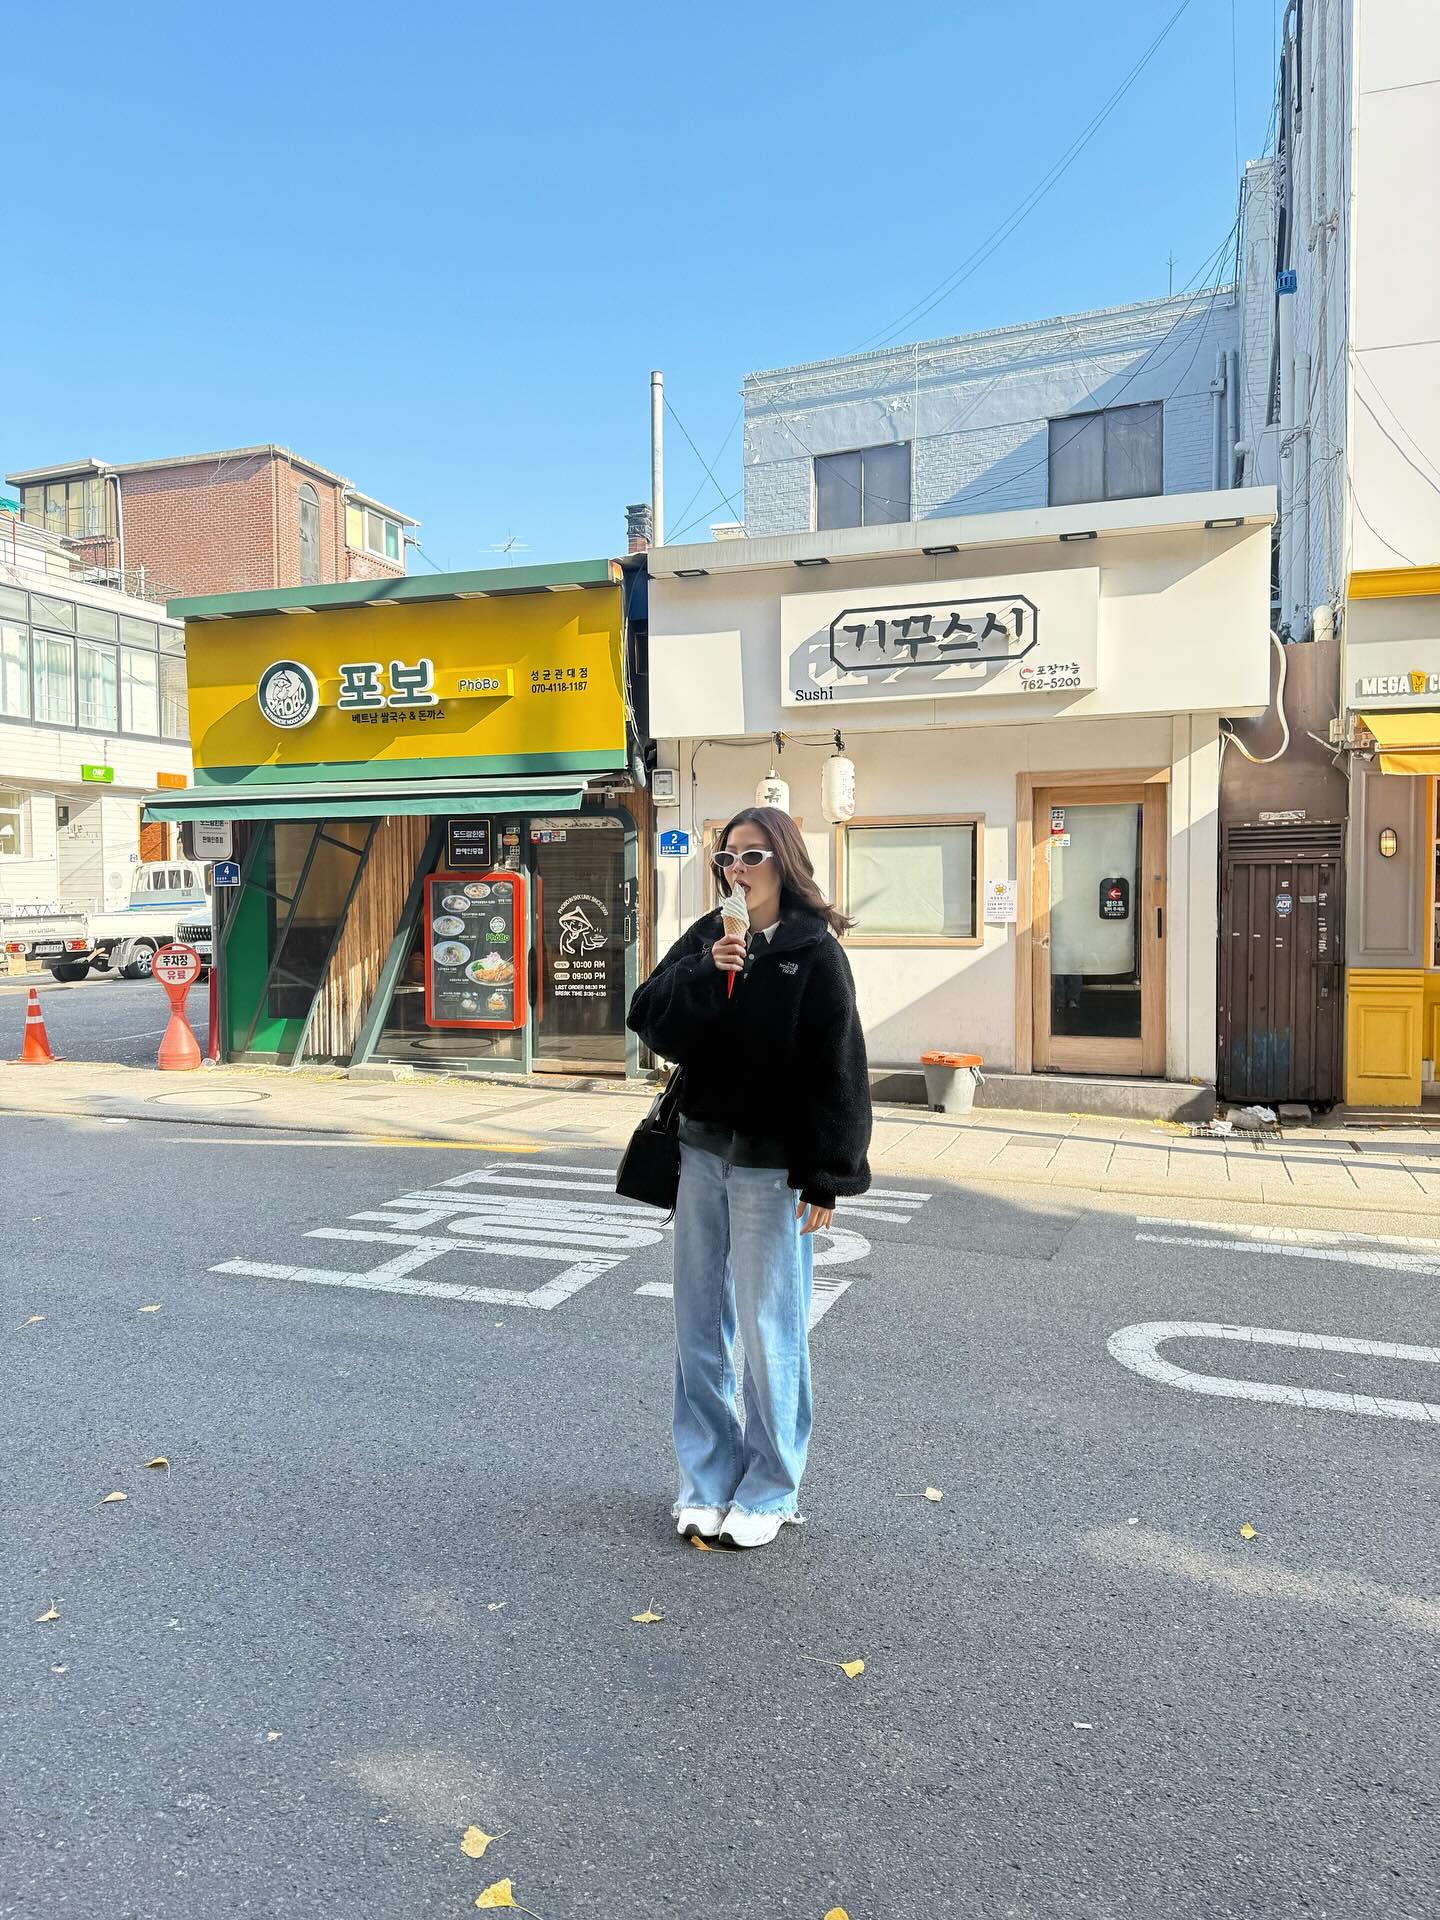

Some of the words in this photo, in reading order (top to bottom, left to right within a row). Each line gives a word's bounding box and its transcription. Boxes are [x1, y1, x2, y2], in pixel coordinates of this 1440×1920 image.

[842, 607, 1025, 662] 기꾸스시
[531, 668, 588, 682] 성균관대점
[1036, 662, 1081, 676] 포장가능
[338, 659, 437, 710] 포보
[531, 681, 588, 693] 070-4118-1187
[1021, 677, 1081, 691] 762-5200
[1361, 675, 1411, 695] MEGA
[1429, 673, 1440, 692] C
[795, 686, 834, 702] Sushi
[352, 713, 378, 724] 베트남
[381, 712, 407, 723] 쌀국수
[409, 711, 416, 721] &
[418, 709, 446, 721] 돈까스
[671, 833, 678, 844] 2
[223, 865, 230, 875] 4
[1276, 900, 1292, 909] ADT
[163, 955, 188, 967] 주차장
[572, 961, 592, 969] 10:00
[166, 970, 187, 980] 유료
[572, 972, 592, 980] 09:00
[594, 972, 606, 980] PM
